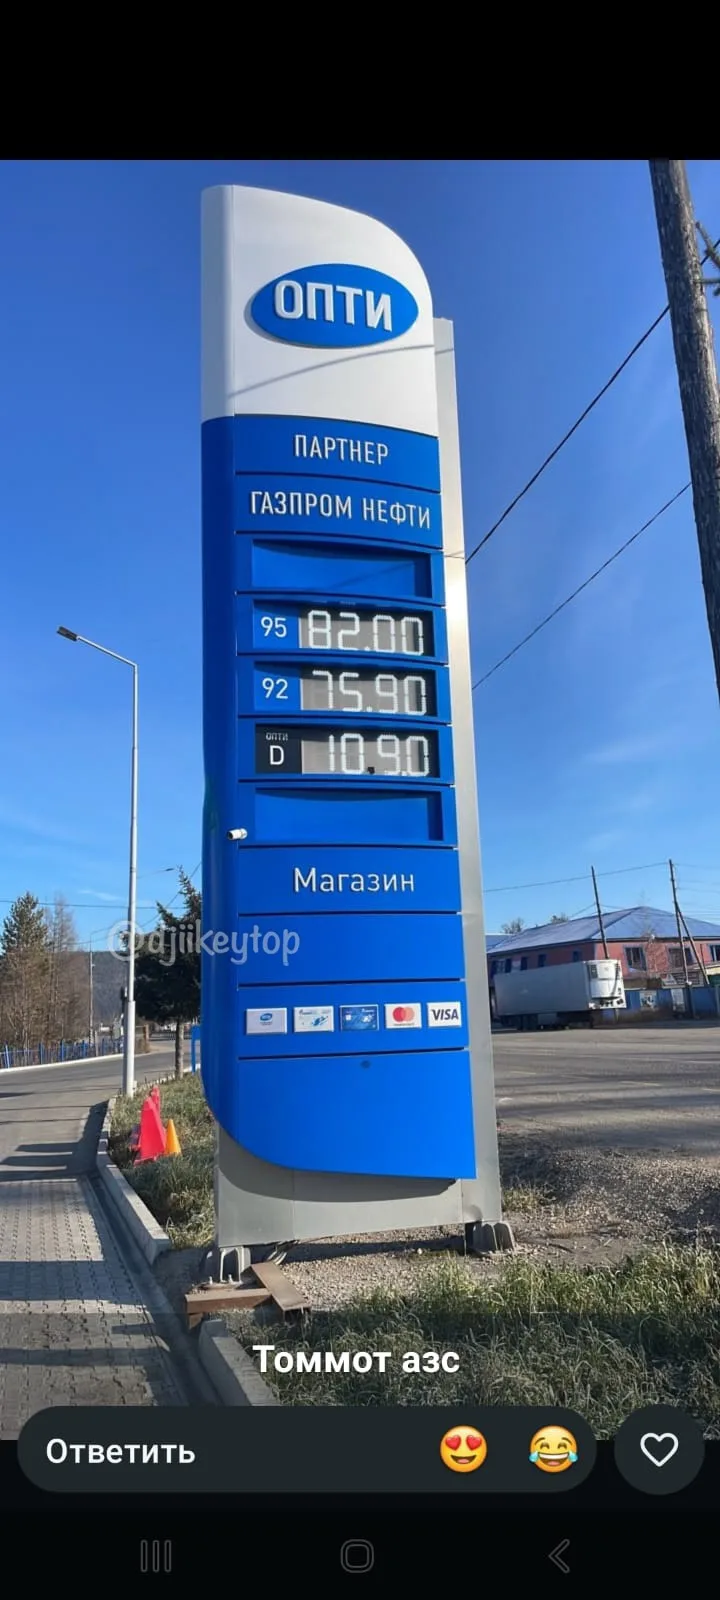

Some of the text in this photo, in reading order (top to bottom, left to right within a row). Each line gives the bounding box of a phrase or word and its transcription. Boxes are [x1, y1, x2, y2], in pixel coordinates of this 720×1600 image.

[274, 280, 392, 332] ОПТИ
[293, 434, 389, 466] ПАРТНЕР
[250, 490, 431, 530] ГАЗПРОМ НЕФТИ
[260, 609, 424, 656] 95 82.00
[261, 669, 427, 716] 92 75.90
[269, 745, 285, 766] D
[293, 867, 415, 893] Магазин
[431, 1008, 459, 1021] VISA
